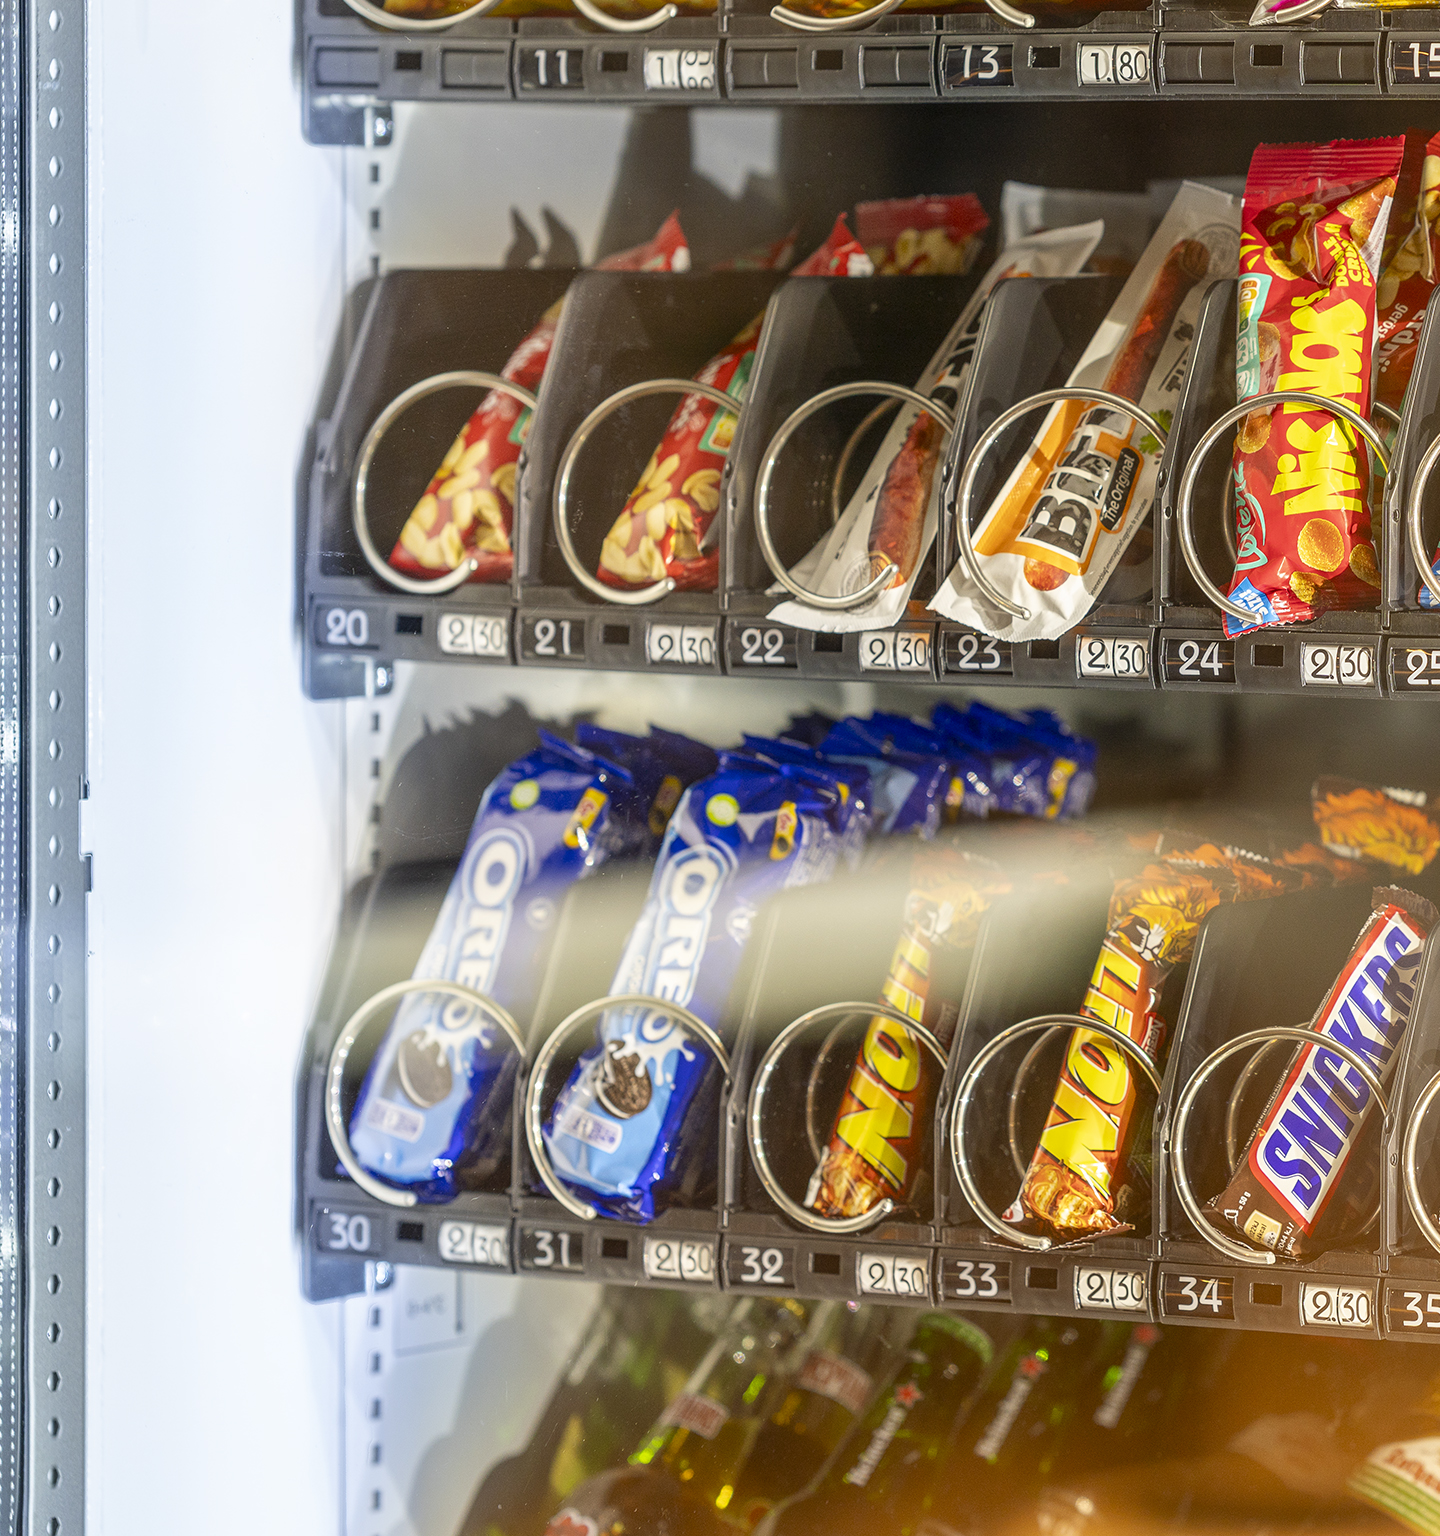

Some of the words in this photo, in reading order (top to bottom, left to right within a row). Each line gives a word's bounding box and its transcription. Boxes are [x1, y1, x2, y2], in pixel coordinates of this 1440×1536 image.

[534, 50, 569, 86] 11
[961, 45, 999, 79] 13
[1111, 452, 1137, 509] Original
[1101, 498, 1123, 523] The
[326, 609, 369, 646] 20
[534, 619, 572, 656] 21
[741, 628, 786, 665] 22
[958, 634, 1001, 670] 23
[1178, 640, 1224, 677] 24
[1264, 925, 1423, 1211] SNICKERS
[329, 1213, 371, 1252] 30
[534, 1230, 570, 1268] 31
[741, 1247, 786, 1284] 32
[956, 1260, 999, 1297] 33
[1178, 1276, 1223, 1313] 34
